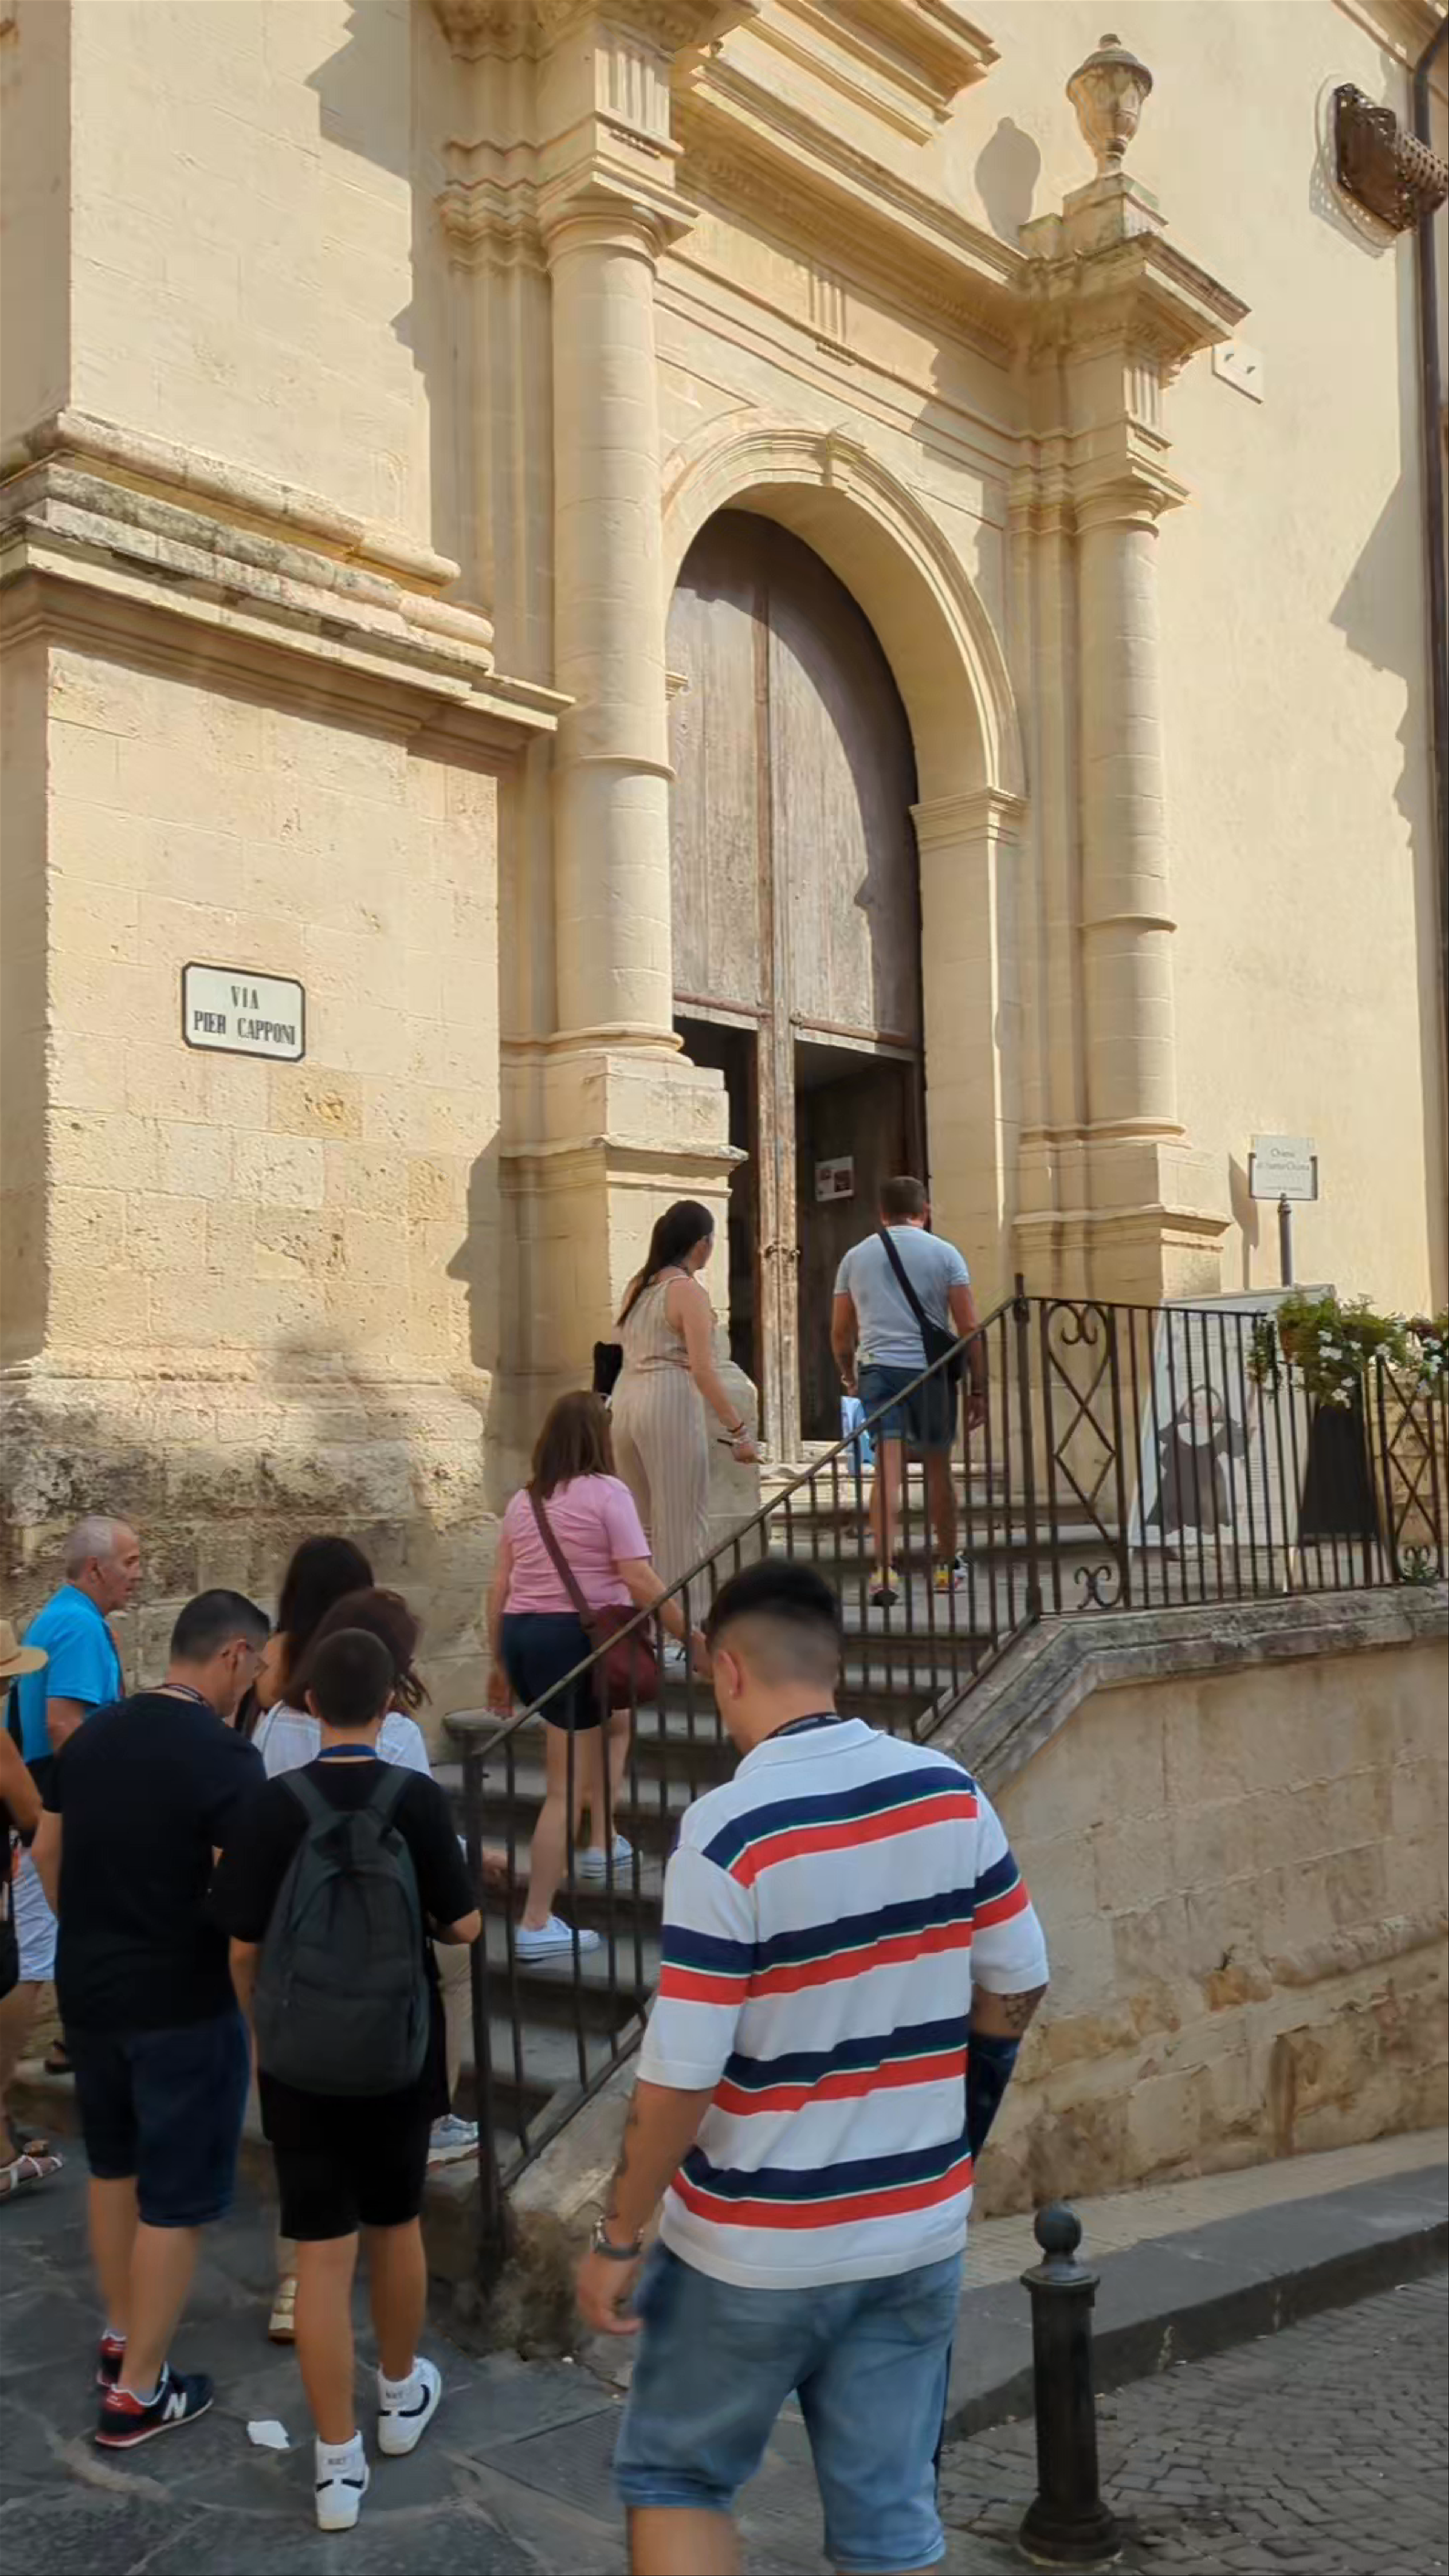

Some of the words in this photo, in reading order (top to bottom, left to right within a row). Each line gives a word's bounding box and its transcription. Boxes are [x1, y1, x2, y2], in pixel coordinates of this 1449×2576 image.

[231, 986, 259, 1009] VIA
[194, 1010, 226, 1035] PIER
[237, 1017, 295, 1045] CAPPONI
[163, 2392, 187, 2420] N
